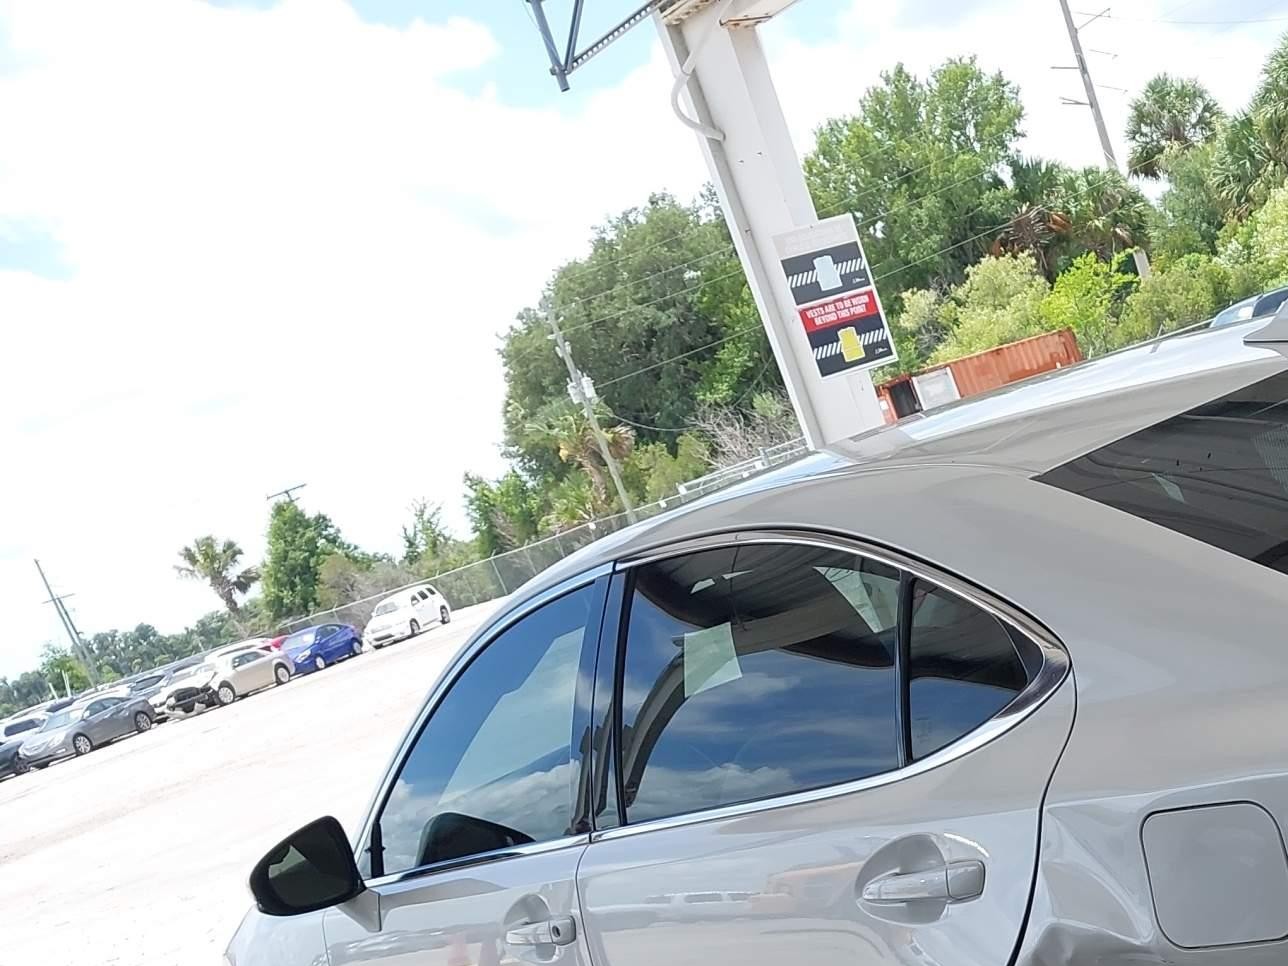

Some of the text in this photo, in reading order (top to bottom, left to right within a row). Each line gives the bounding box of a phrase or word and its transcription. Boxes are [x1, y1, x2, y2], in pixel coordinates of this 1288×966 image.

[806, 307, 825, 318] VESTS
[824, 304, 836, 313] ARE
[835, 301, 844, 310] TO
[843, 298, 852, 307] BE
[814, 304, 867, 326] BEYOND THIS POINT
